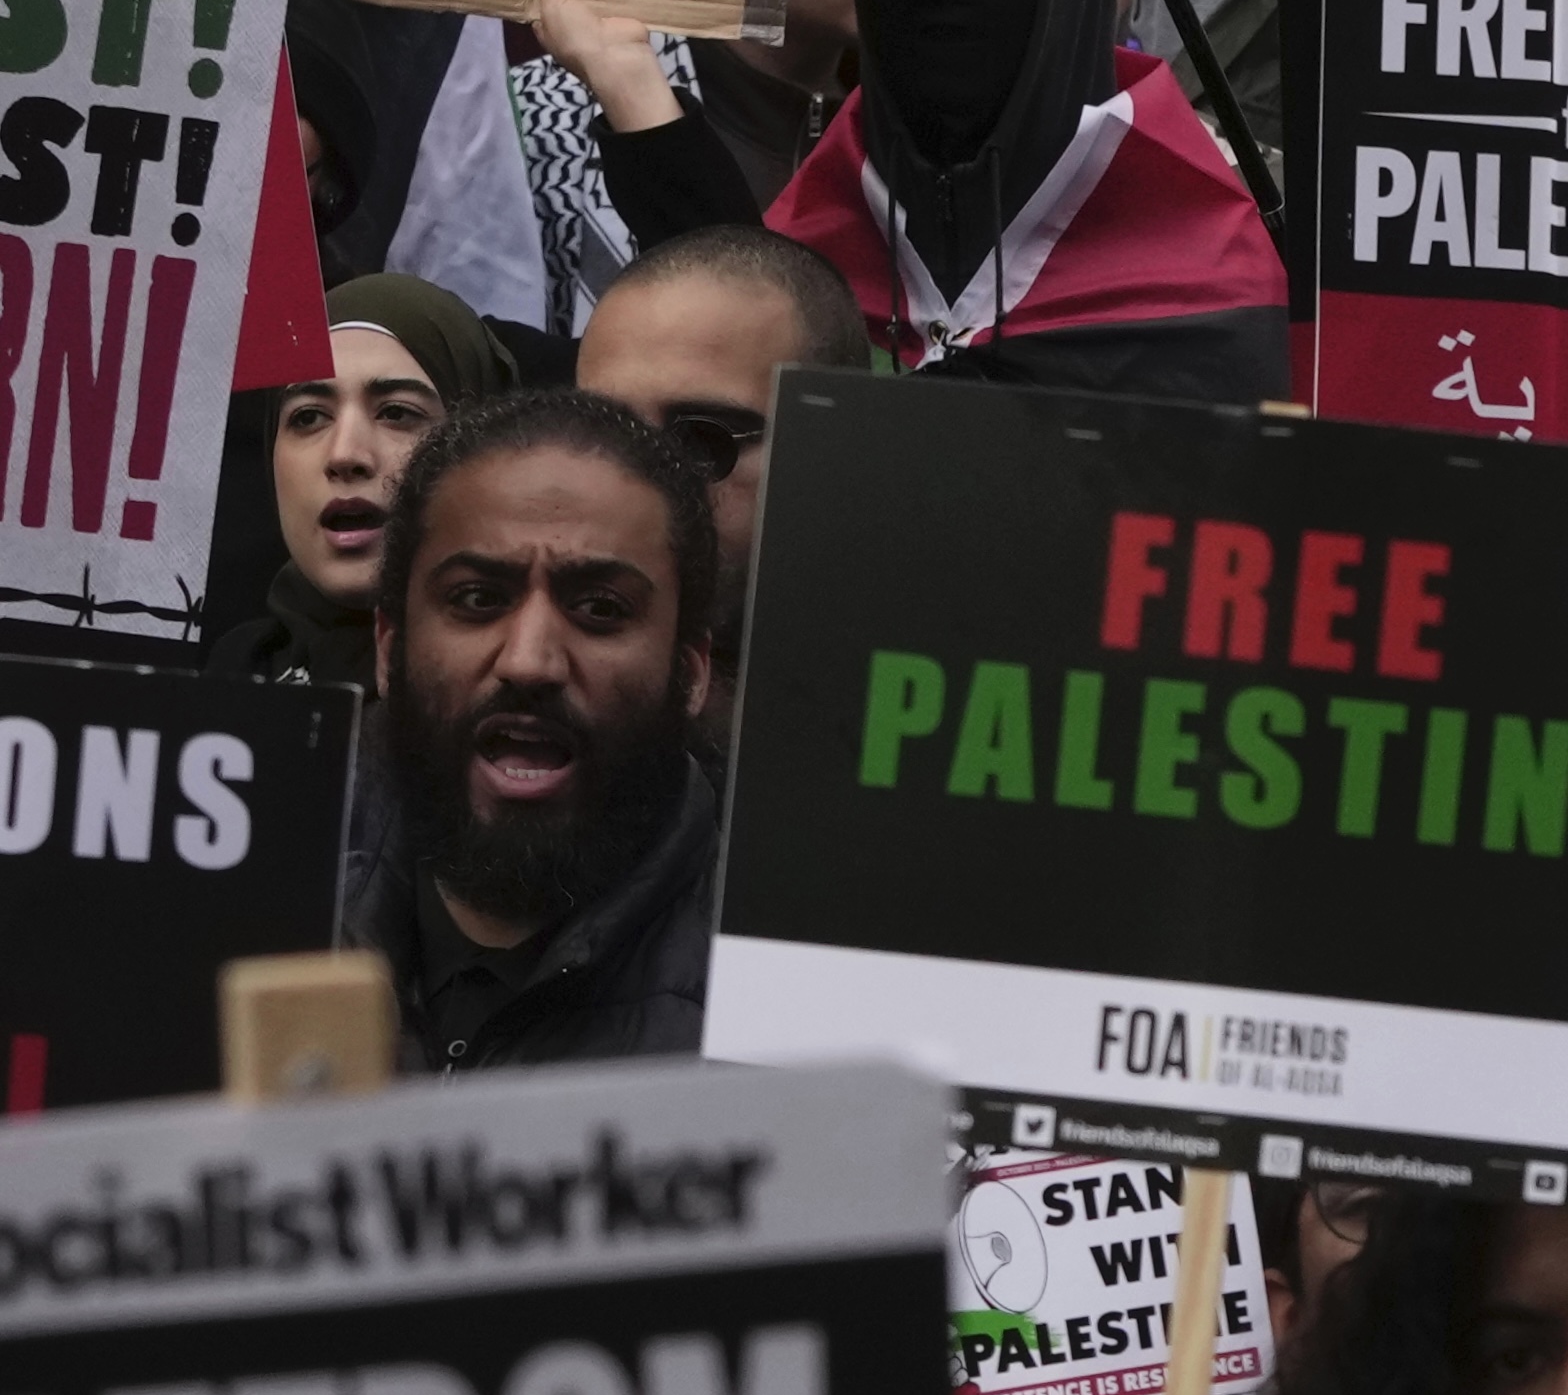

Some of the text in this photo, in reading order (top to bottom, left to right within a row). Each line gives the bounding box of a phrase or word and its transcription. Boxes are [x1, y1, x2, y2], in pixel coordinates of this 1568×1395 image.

[1099, 512, 1454, 682] FREE
[1094, 1004, 1350, 1084] FOA FRIENDS
[382, 1118, 769, 1264] Worker
[1097, 1374, 1119, 1395] IS
